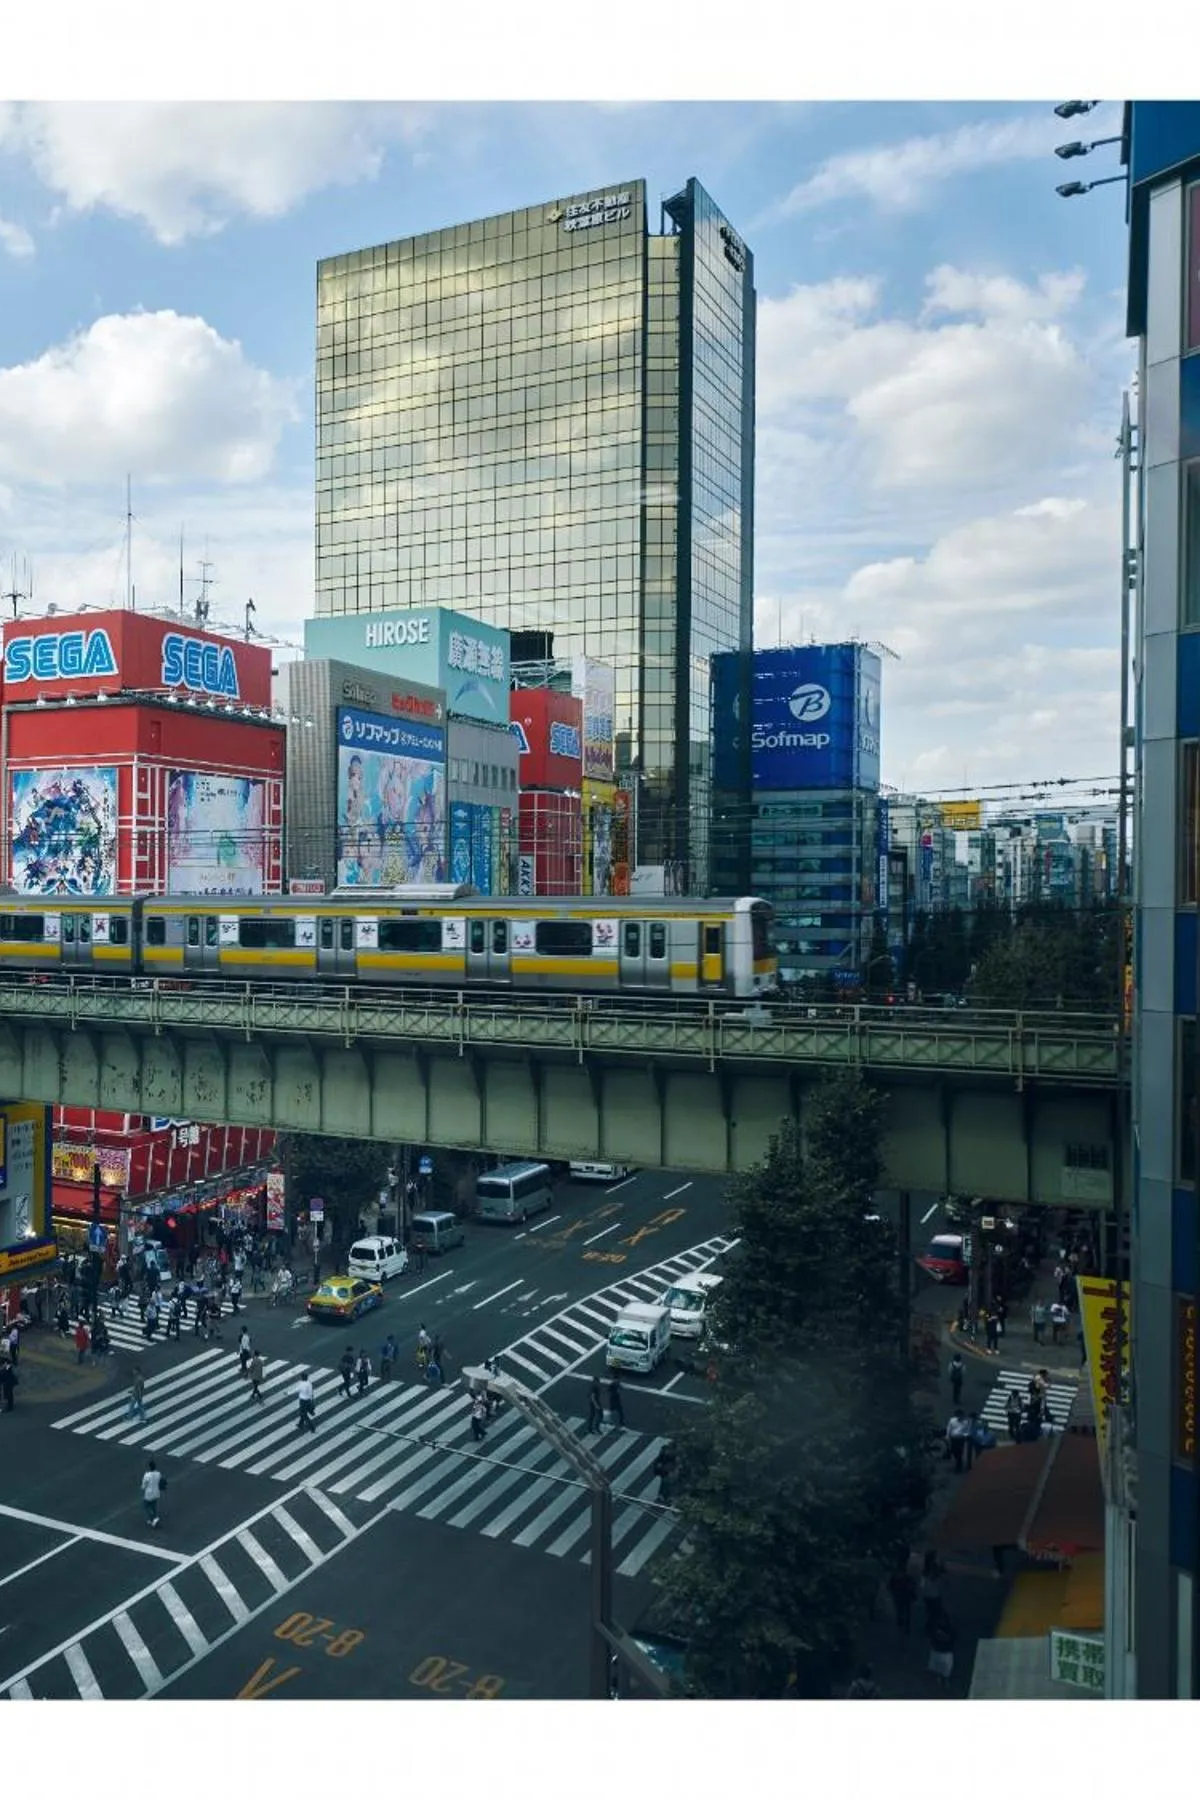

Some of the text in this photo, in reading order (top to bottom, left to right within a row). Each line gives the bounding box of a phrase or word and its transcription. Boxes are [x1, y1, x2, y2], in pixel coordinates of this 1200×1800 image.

[565, 192, 632, 219] 住友不動産
[365, 617, 431, 649] HIROSE
[5, 628, 119, 684] SEGA
[161, 630, 240, 699] SEGA
[355, 720, 400, 745] ソフマップ
[751, 731, 830, 749] Sofmap
